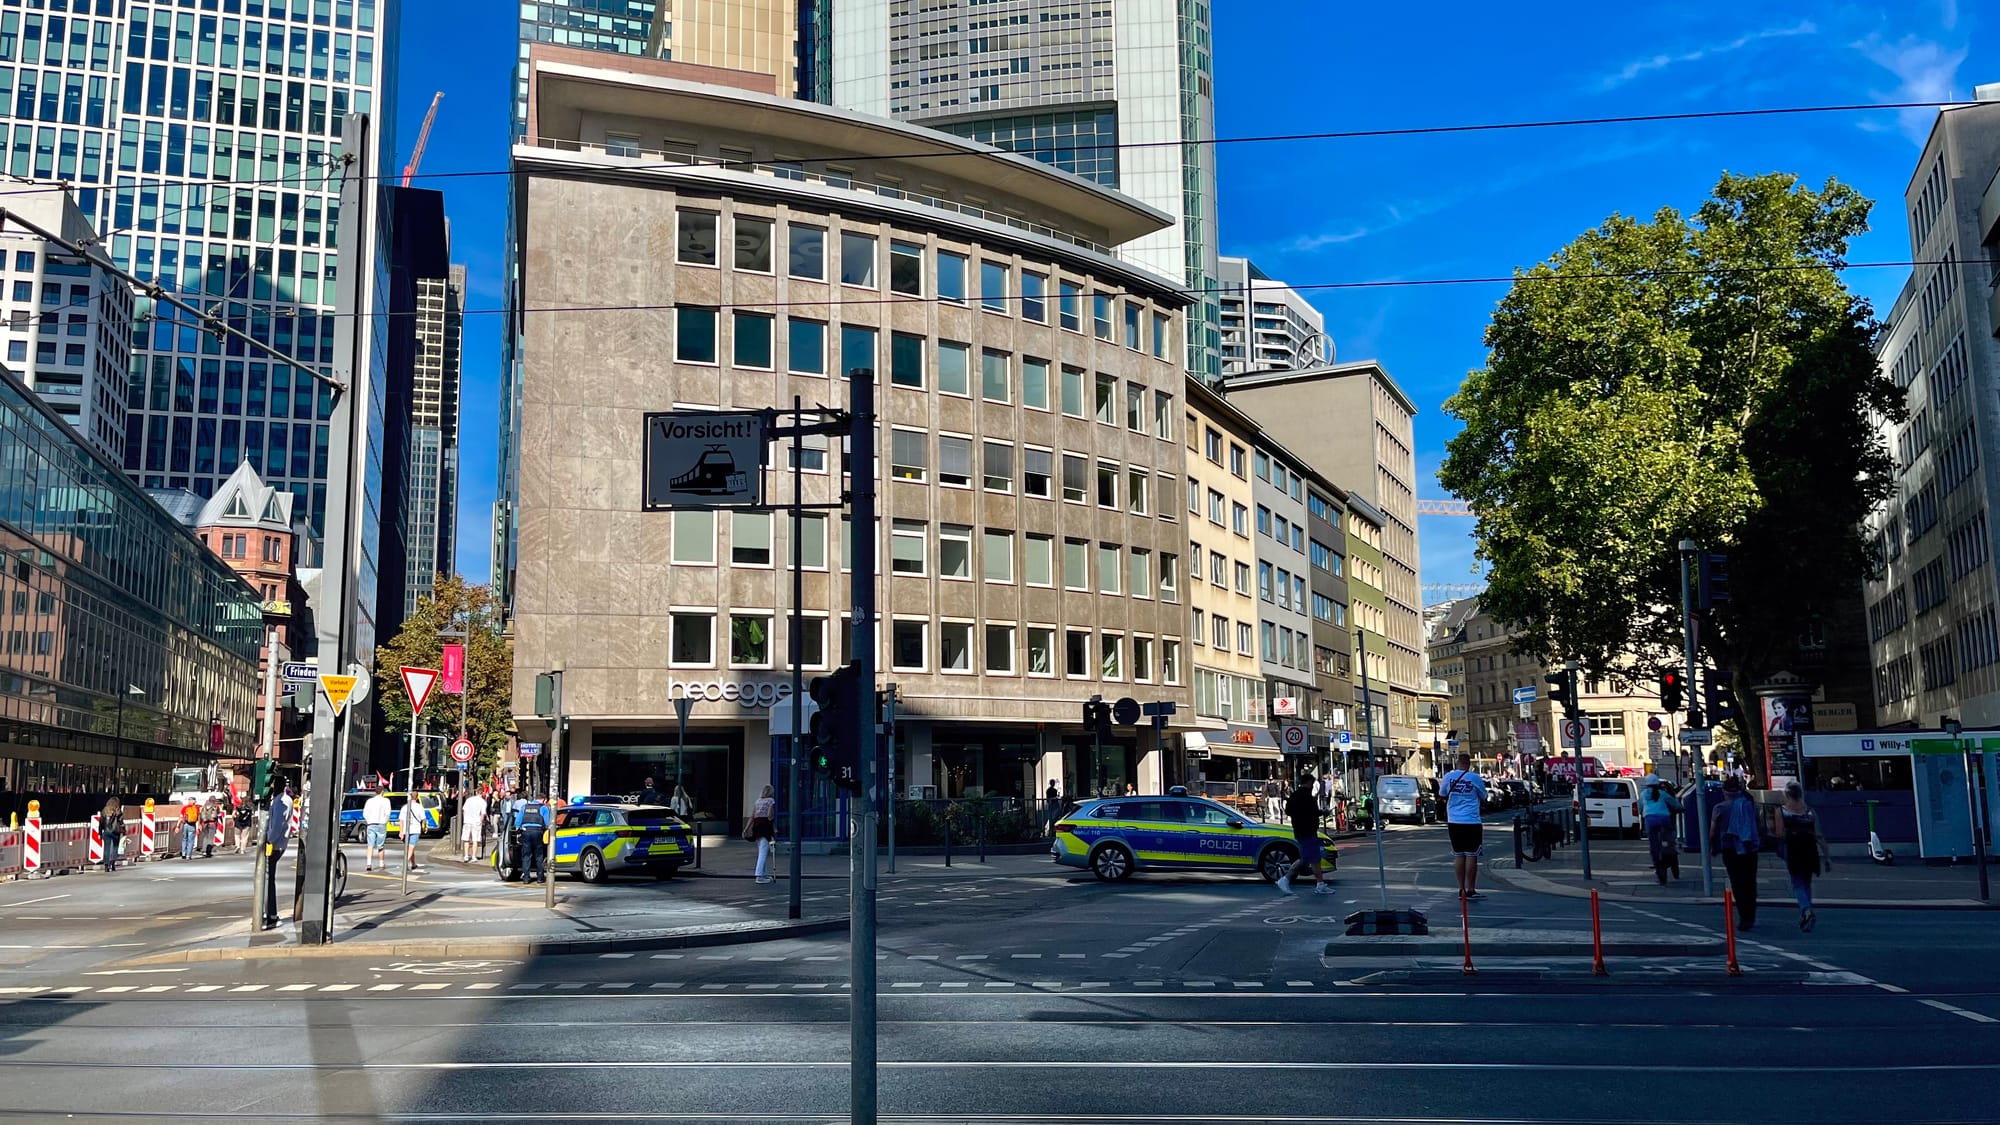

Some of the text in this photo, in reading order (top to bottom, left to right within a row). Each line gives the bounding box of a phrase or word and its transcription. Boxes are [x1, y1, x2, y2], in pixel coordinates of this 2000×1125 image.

[661, 420, 752, 439] Vorsicht!
[290, 666, 316, 677] Frieden
[668, 676, 794, 707] hedegge
[1290, 732, 1299, 741] 20
[457, 746, 470, 755] 40
[1880, 740, 1911, 750] Willy-B
[841, 766, 852, 779] 31
[1551, 763, 1593, 772] ARNT
[1199, 839, 1243, 851] POLIZEI
